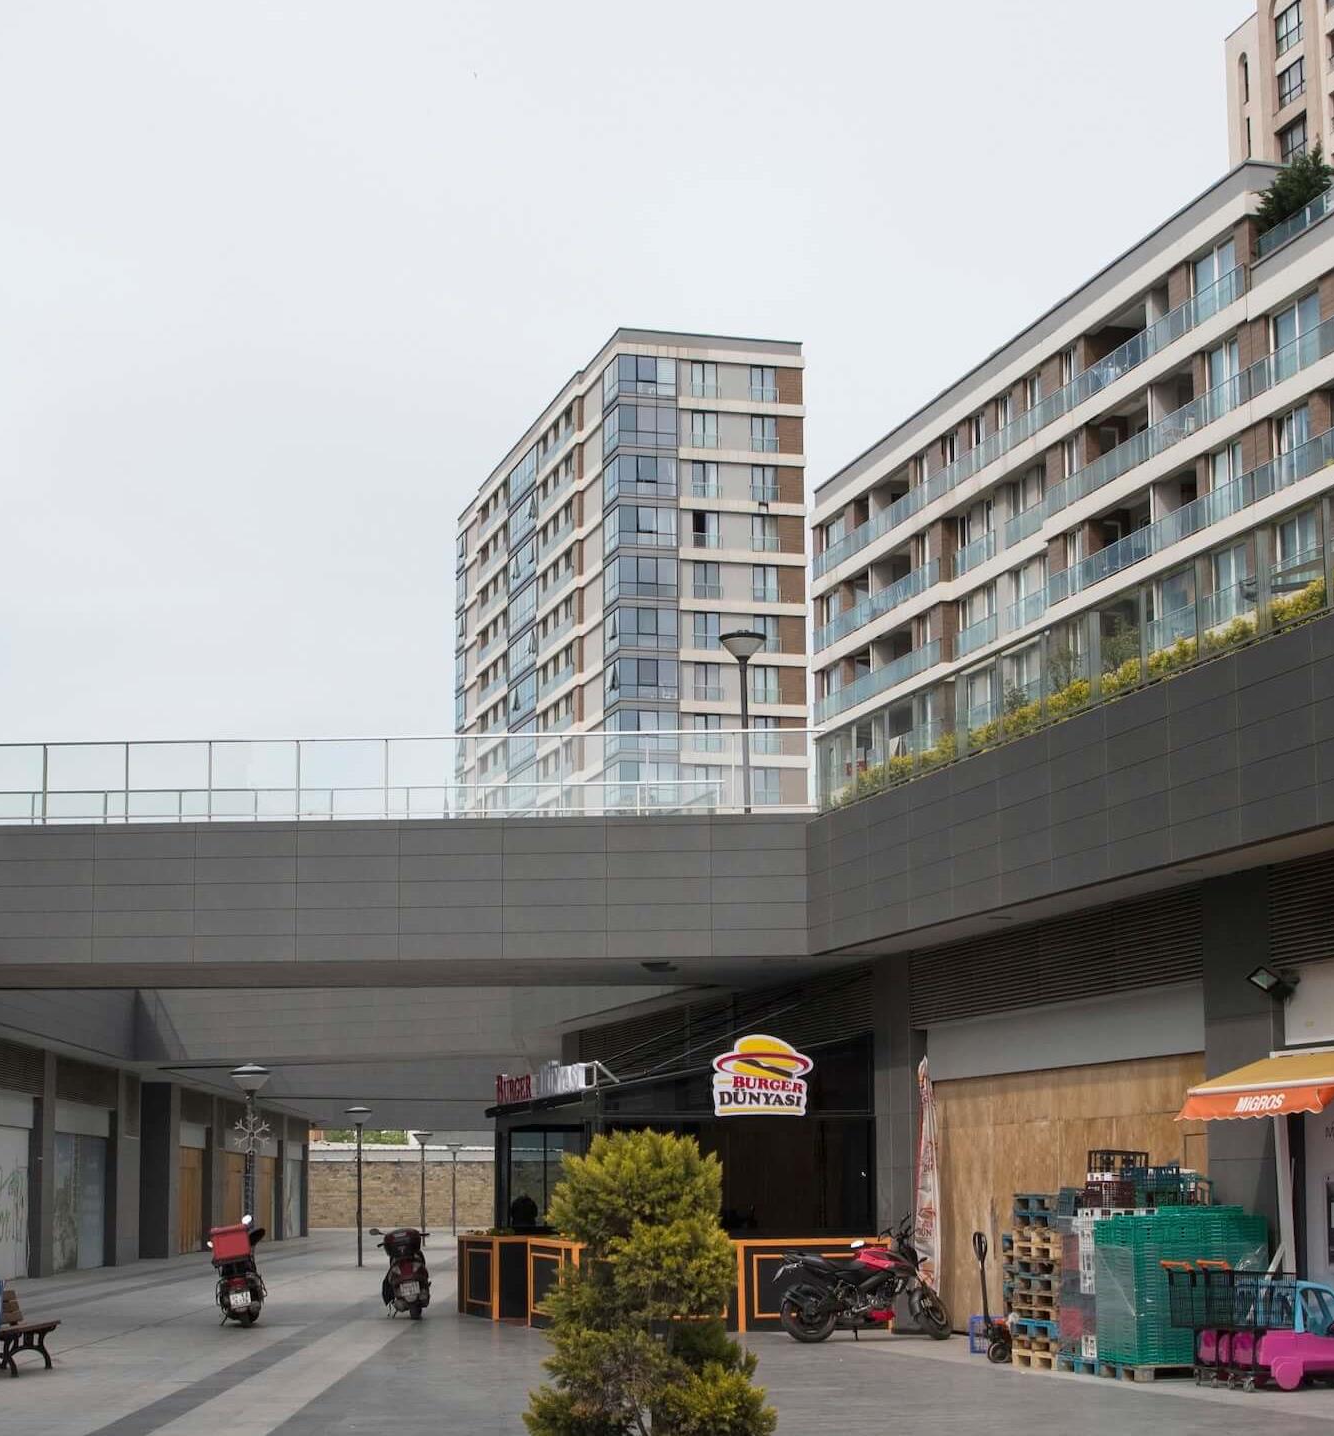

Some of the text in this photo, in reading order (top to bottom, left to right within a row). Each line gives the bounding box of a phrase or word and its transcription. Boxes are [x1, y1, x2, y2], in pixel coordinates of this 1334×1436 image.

[496, 1074, 532, 1103] BURGER
[732, 1075, 804, 1094] BURGER
[718, 1086, 804, 1108] DÜNYASI
